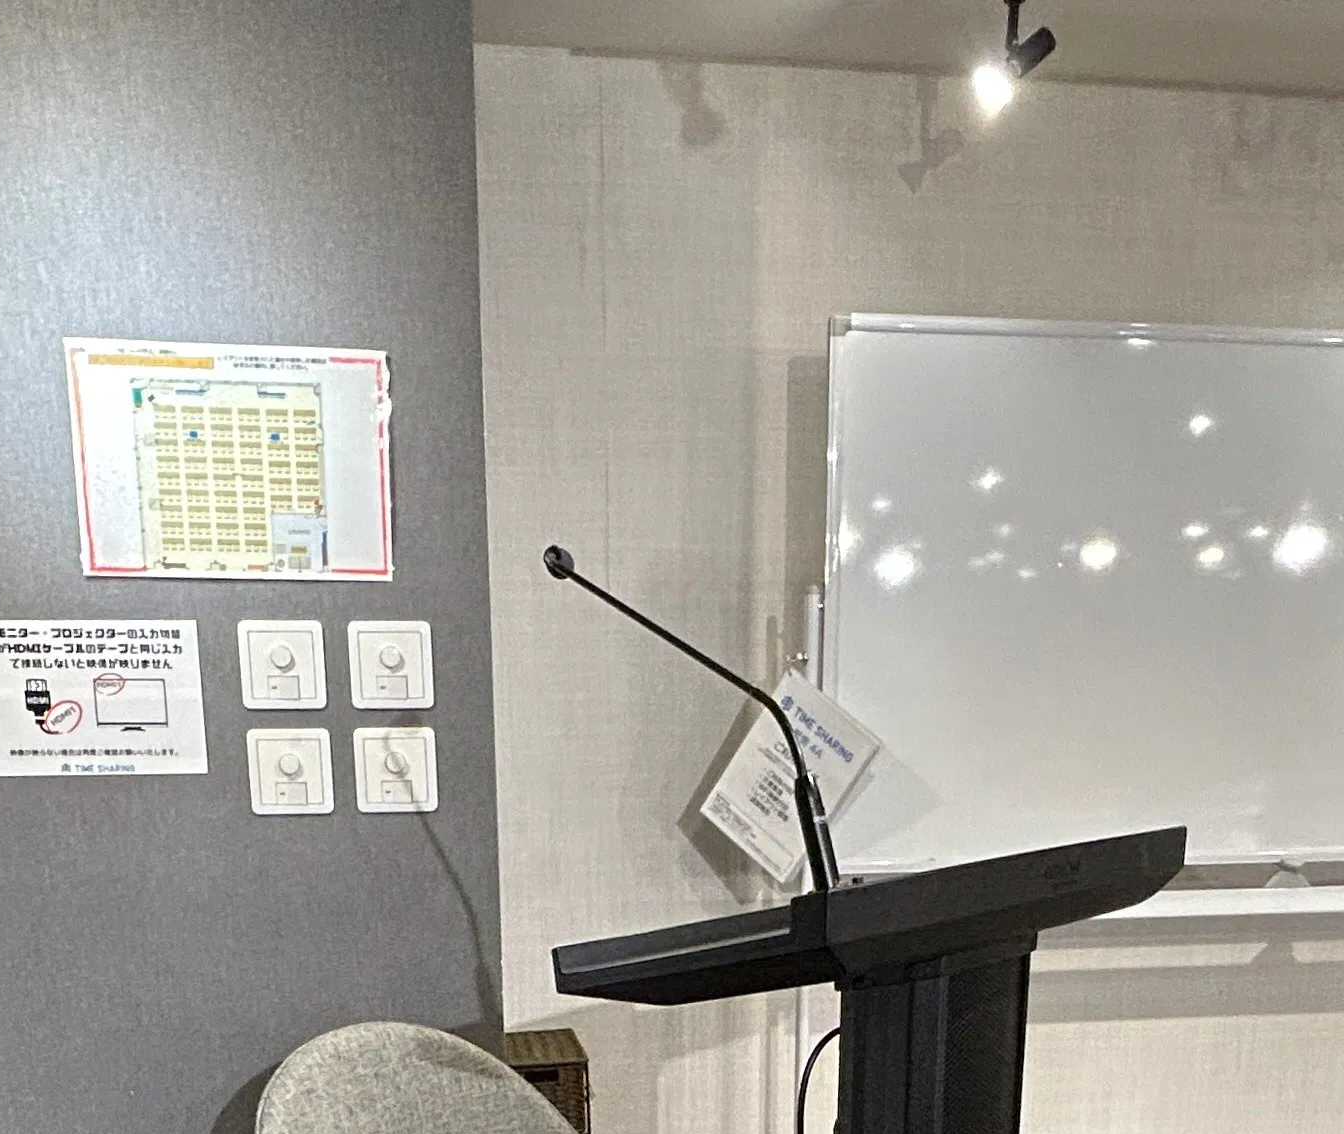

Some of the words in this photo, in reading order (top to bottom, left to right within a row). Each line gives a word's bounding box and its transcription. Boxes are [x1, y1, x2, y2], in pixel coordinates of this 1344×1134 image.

[794, 707, 816, 729] TIME
[815, 725, 855, 763] SHARING
[75, 765, 94, 773] TIME
[97, 765, 136, 773] SHARING
